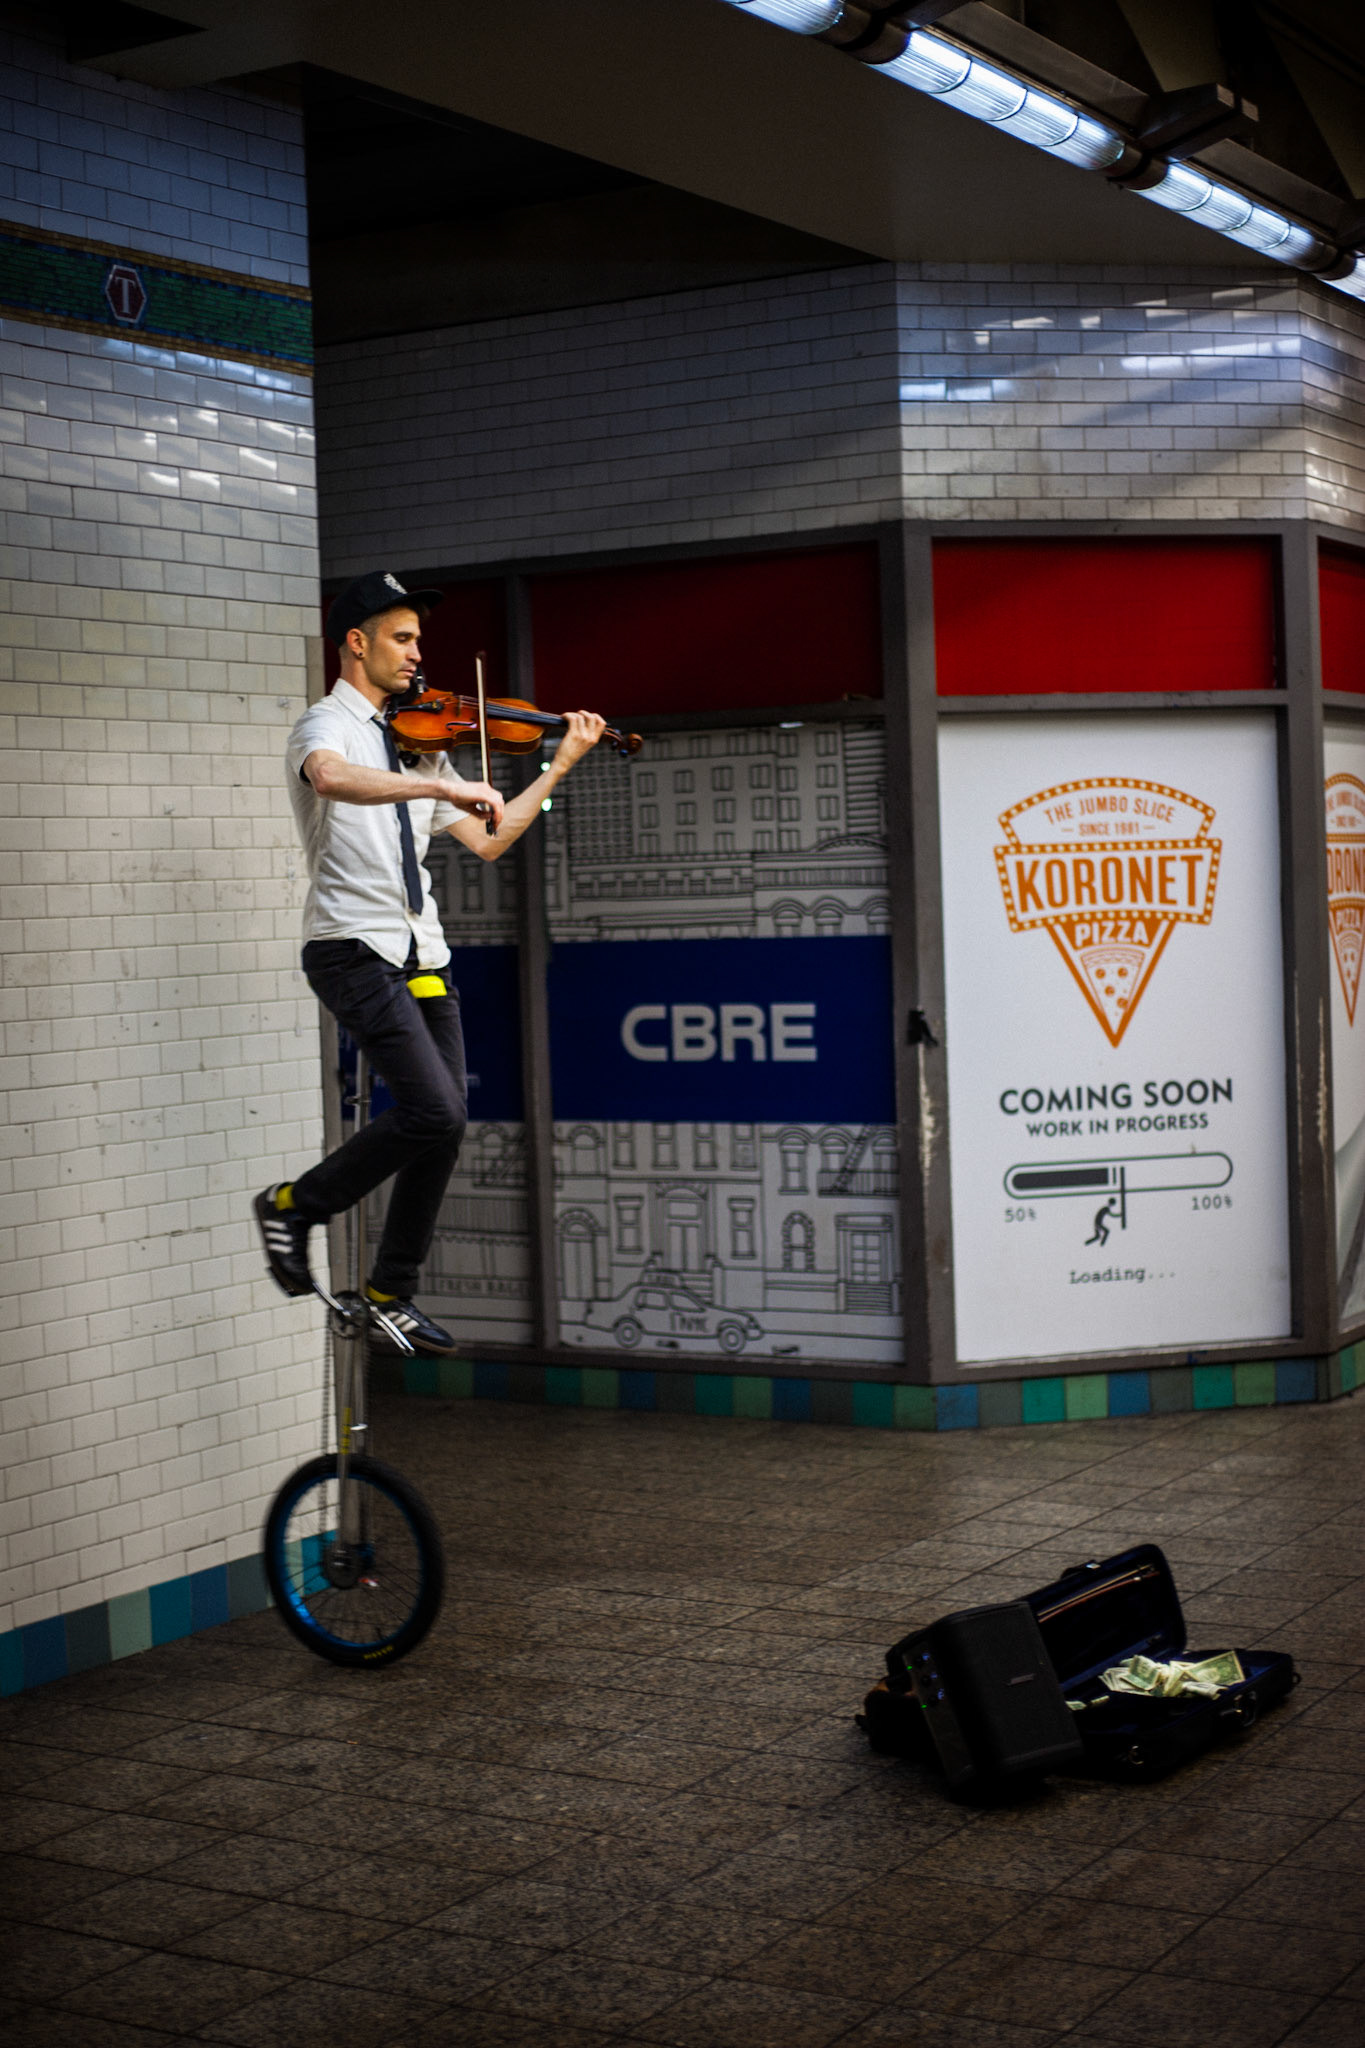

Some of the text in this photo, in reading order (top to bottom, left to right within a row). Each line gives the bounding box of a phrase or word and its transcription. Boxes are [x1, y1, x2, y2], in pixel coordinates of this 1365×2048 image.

[114, 275, 137, 315] T
[1043, 795, 1176, 825] THE JUMBO SLICE
[1079, 822, 1110, 837] SINCE
[1014, 854, 1204, 914] KORONET
[1326, 847, 1365, 895] ORON
[1074, 918, 1150, 948] PIZZA
[620, 1002, 818, 1062] CBRE
[999, 1077, 1233, 1116] COMING SOON
[1025, 1112, 1210, 1138] WORK IN PROGRESS
[1004, 1206, 1037, 1223] 50%
[1191, 1194, 1233, 1212] 100%
